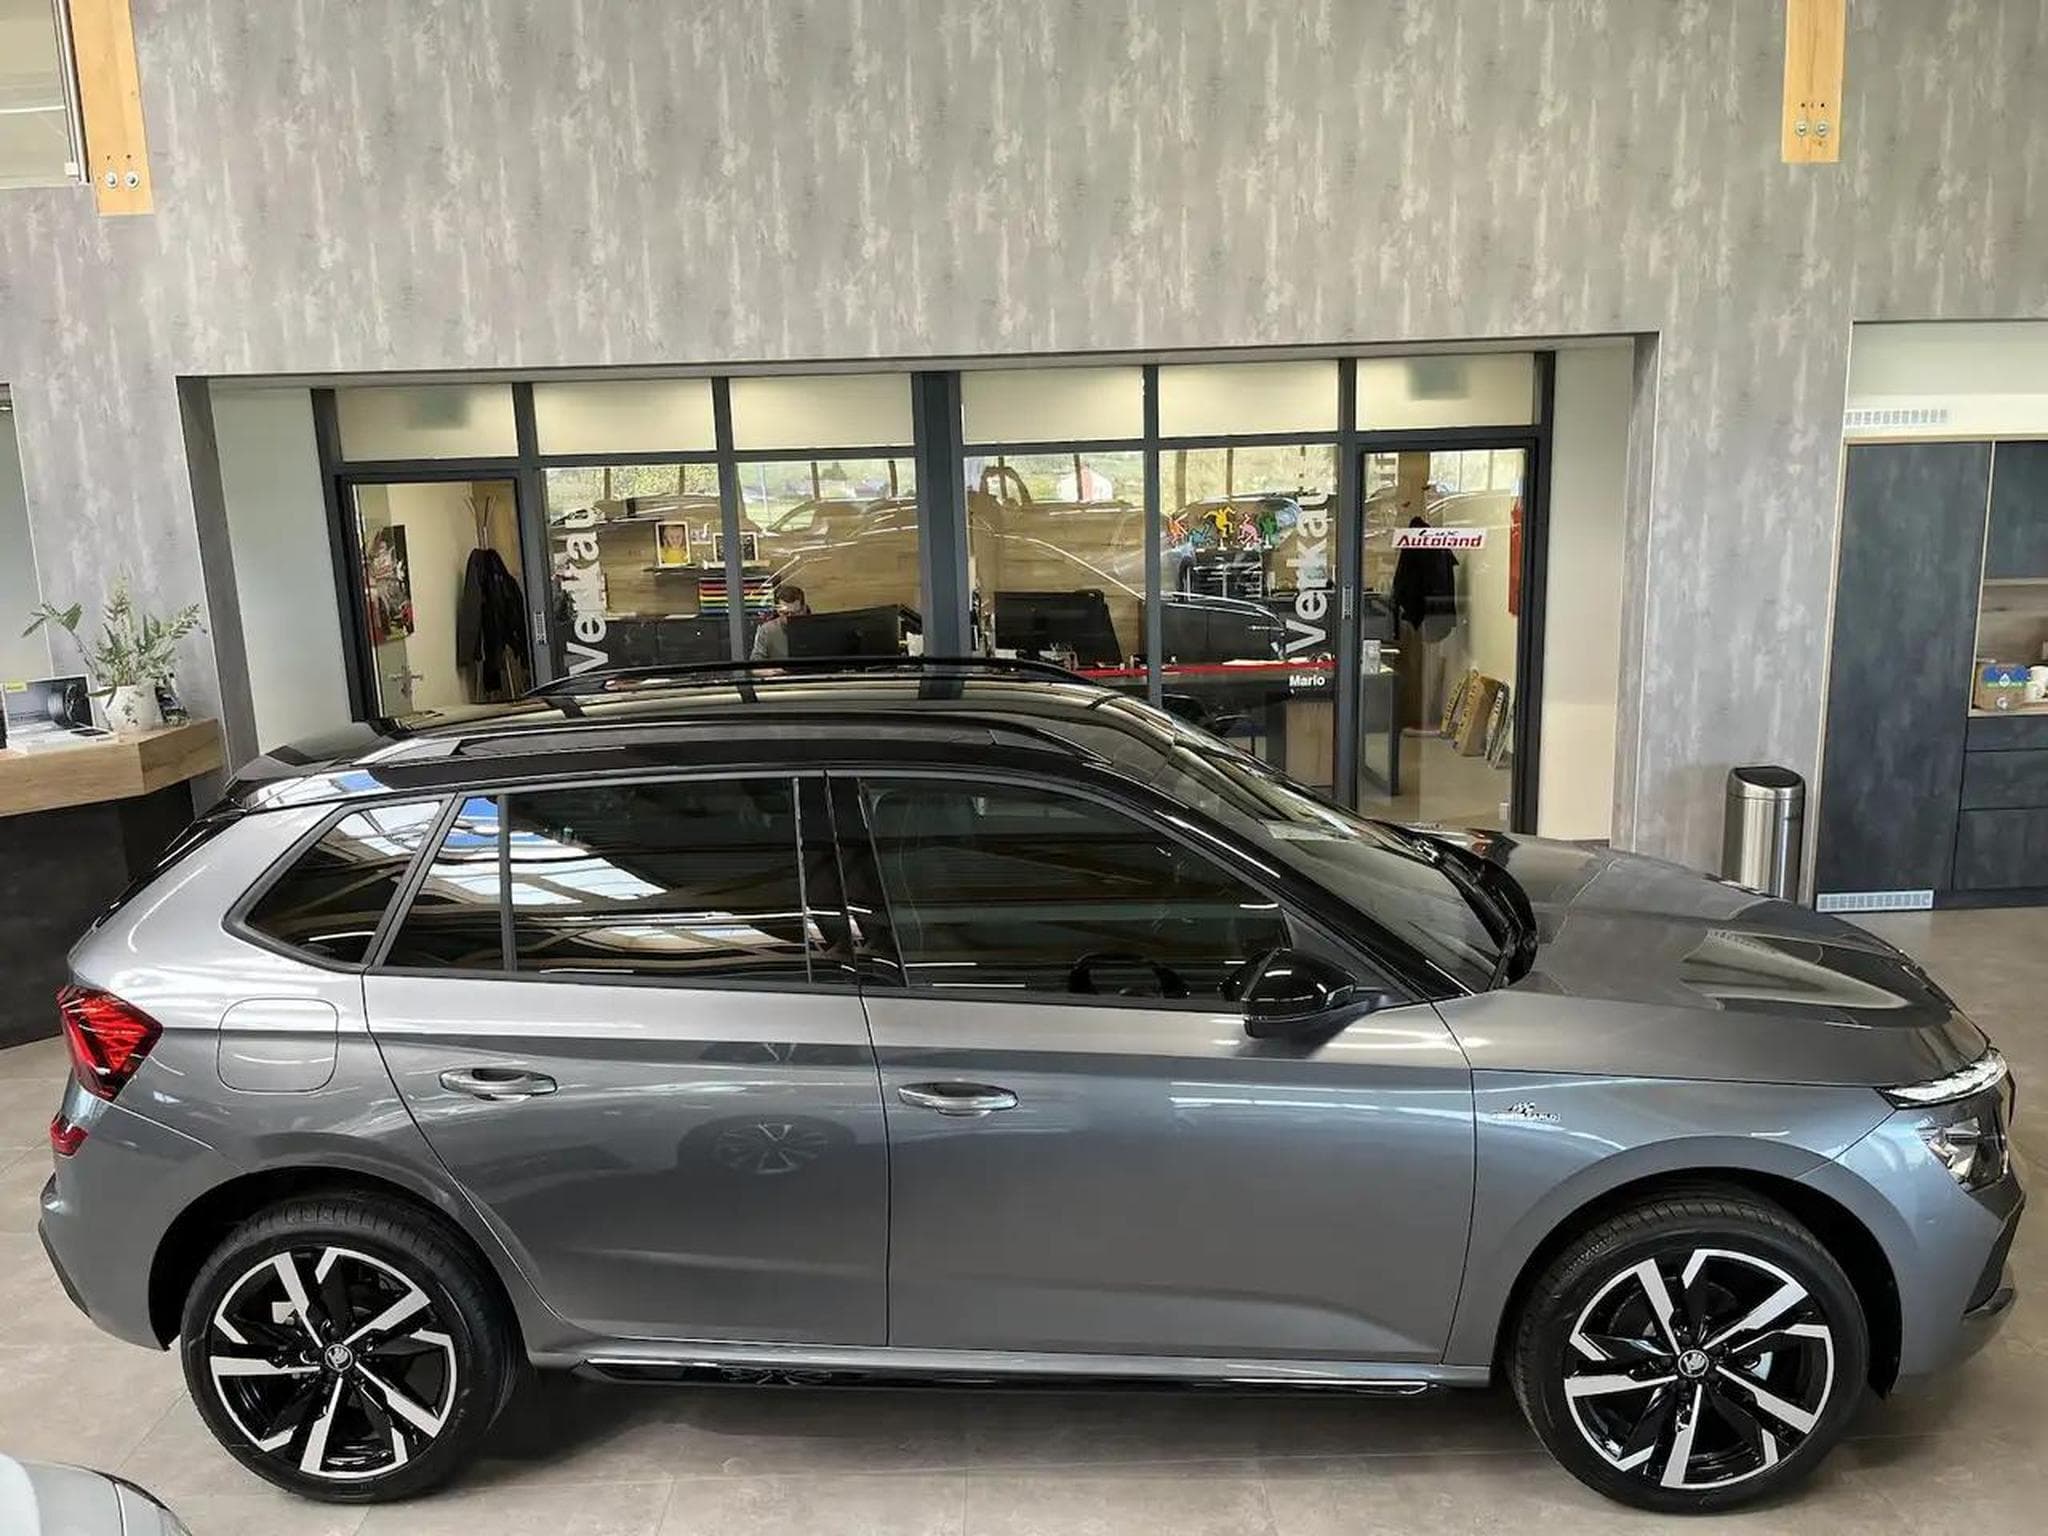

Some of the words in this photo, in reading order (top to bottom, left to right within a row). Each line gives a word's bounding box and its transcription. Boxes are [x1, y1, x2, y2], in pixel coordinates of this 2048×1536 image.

[1286, 480, 1327, 654] Verkau
[1397, 534, 1482, 547] Autoland
[561, 500, 608, 676] Verkau
[1289, 674, 1326, 686] Mario
